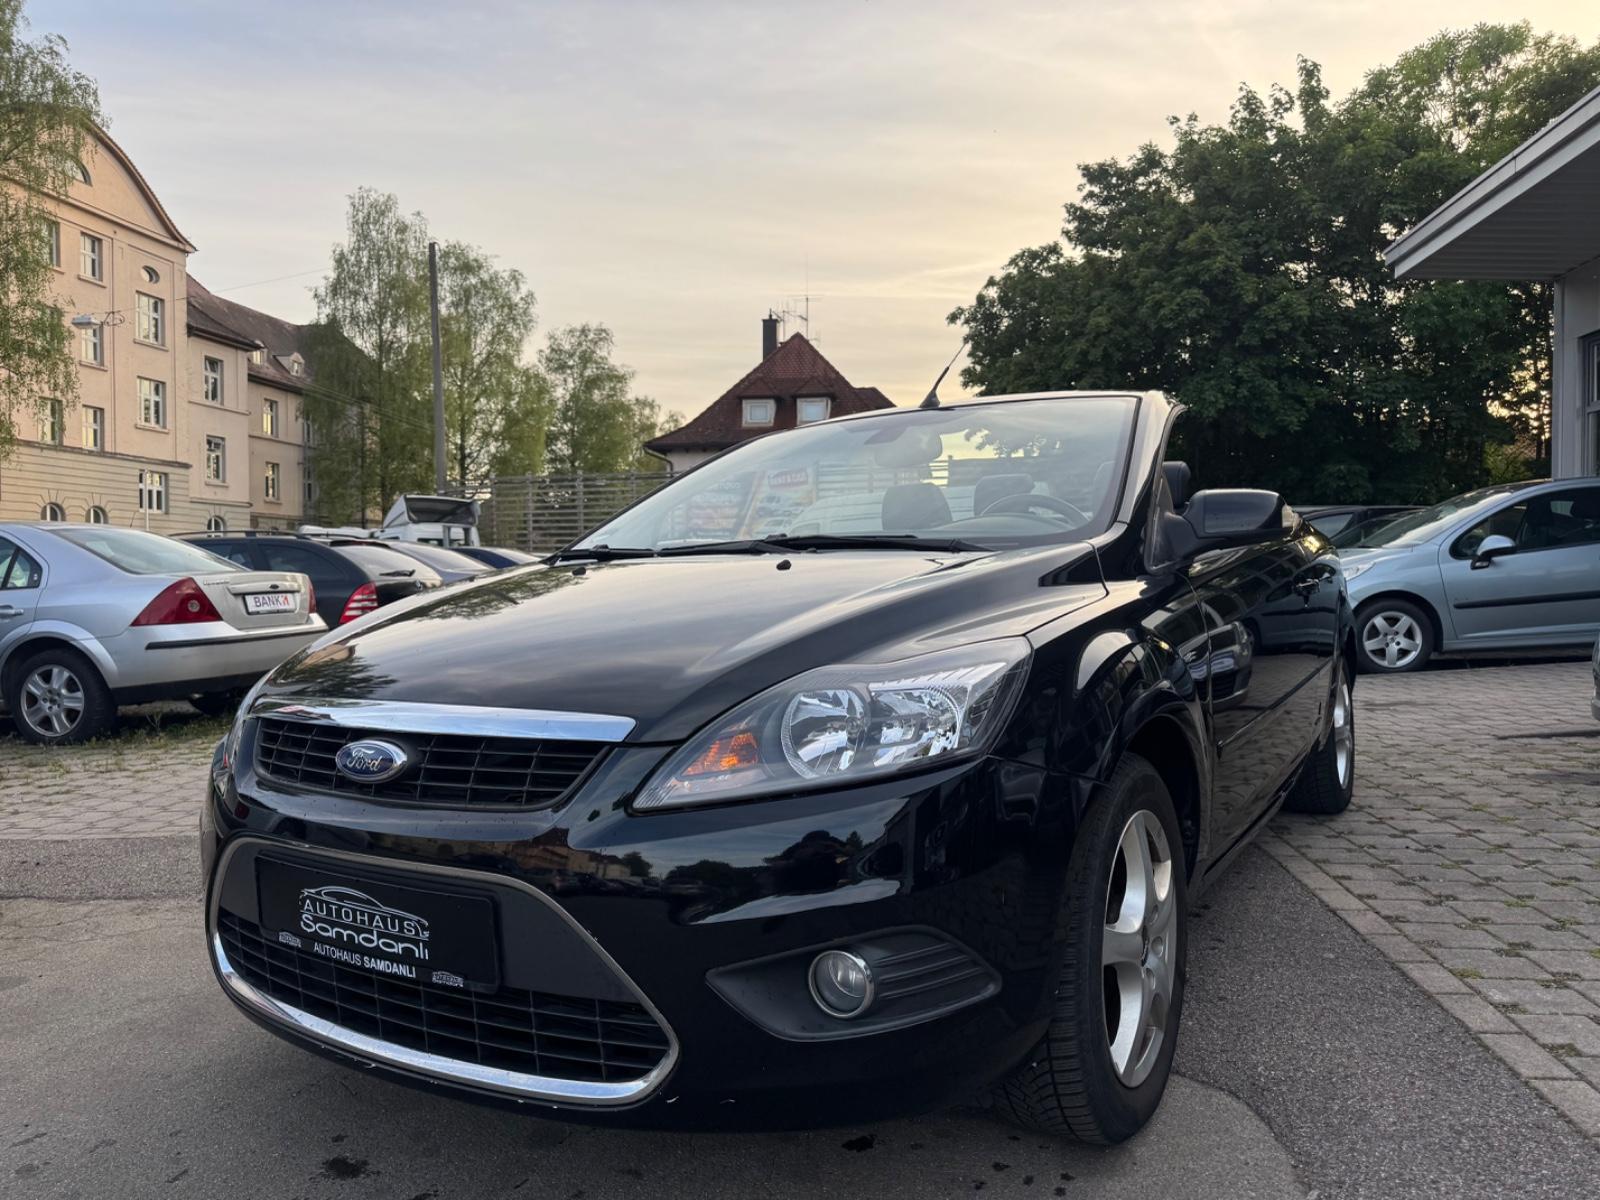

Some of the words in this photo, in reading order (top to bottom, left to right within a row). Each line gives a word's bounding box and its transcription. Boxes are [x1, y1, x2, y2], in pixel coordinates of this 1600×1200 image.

[346, 747, 383, 771] Ford
[303, 899, 416, 935] AUTOHAUS
[313, 941, 362, 966] AUTOHAUS
[363, 956, 416, 979] SAMDANLI
